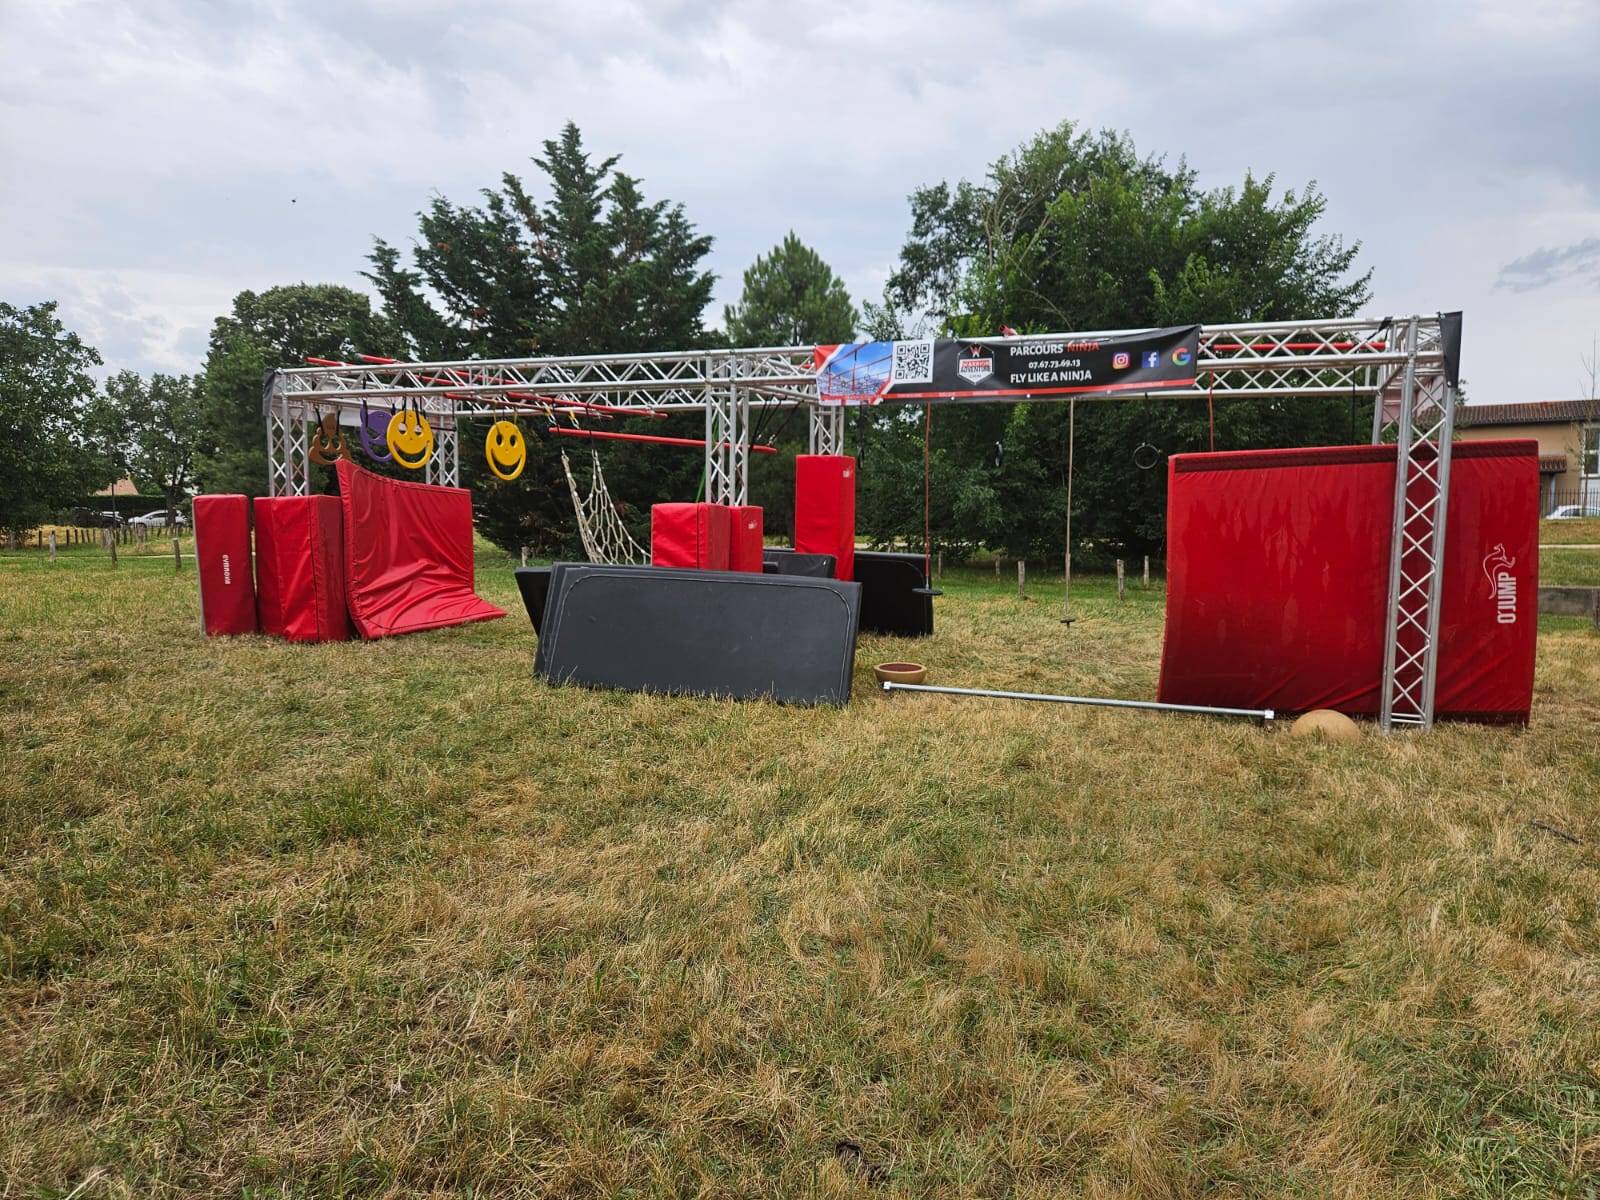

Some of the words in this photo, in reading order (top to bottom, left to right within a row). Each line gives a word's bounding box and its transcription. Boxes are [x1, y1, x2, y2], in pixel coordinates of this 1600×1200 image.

[1010, 343, 1064, 356] PARCOURS
[1066, 341, 1100, 352] NINJA
[1028, 359, 1081, 369] 07.67.73.69.13
[1010, 373, 1026, 383] FLY
[1027, 372, 1050, 382] LIKE
[1050, 372, 1058, 382] A
[1059, 370, 1092, 381] NINJA
